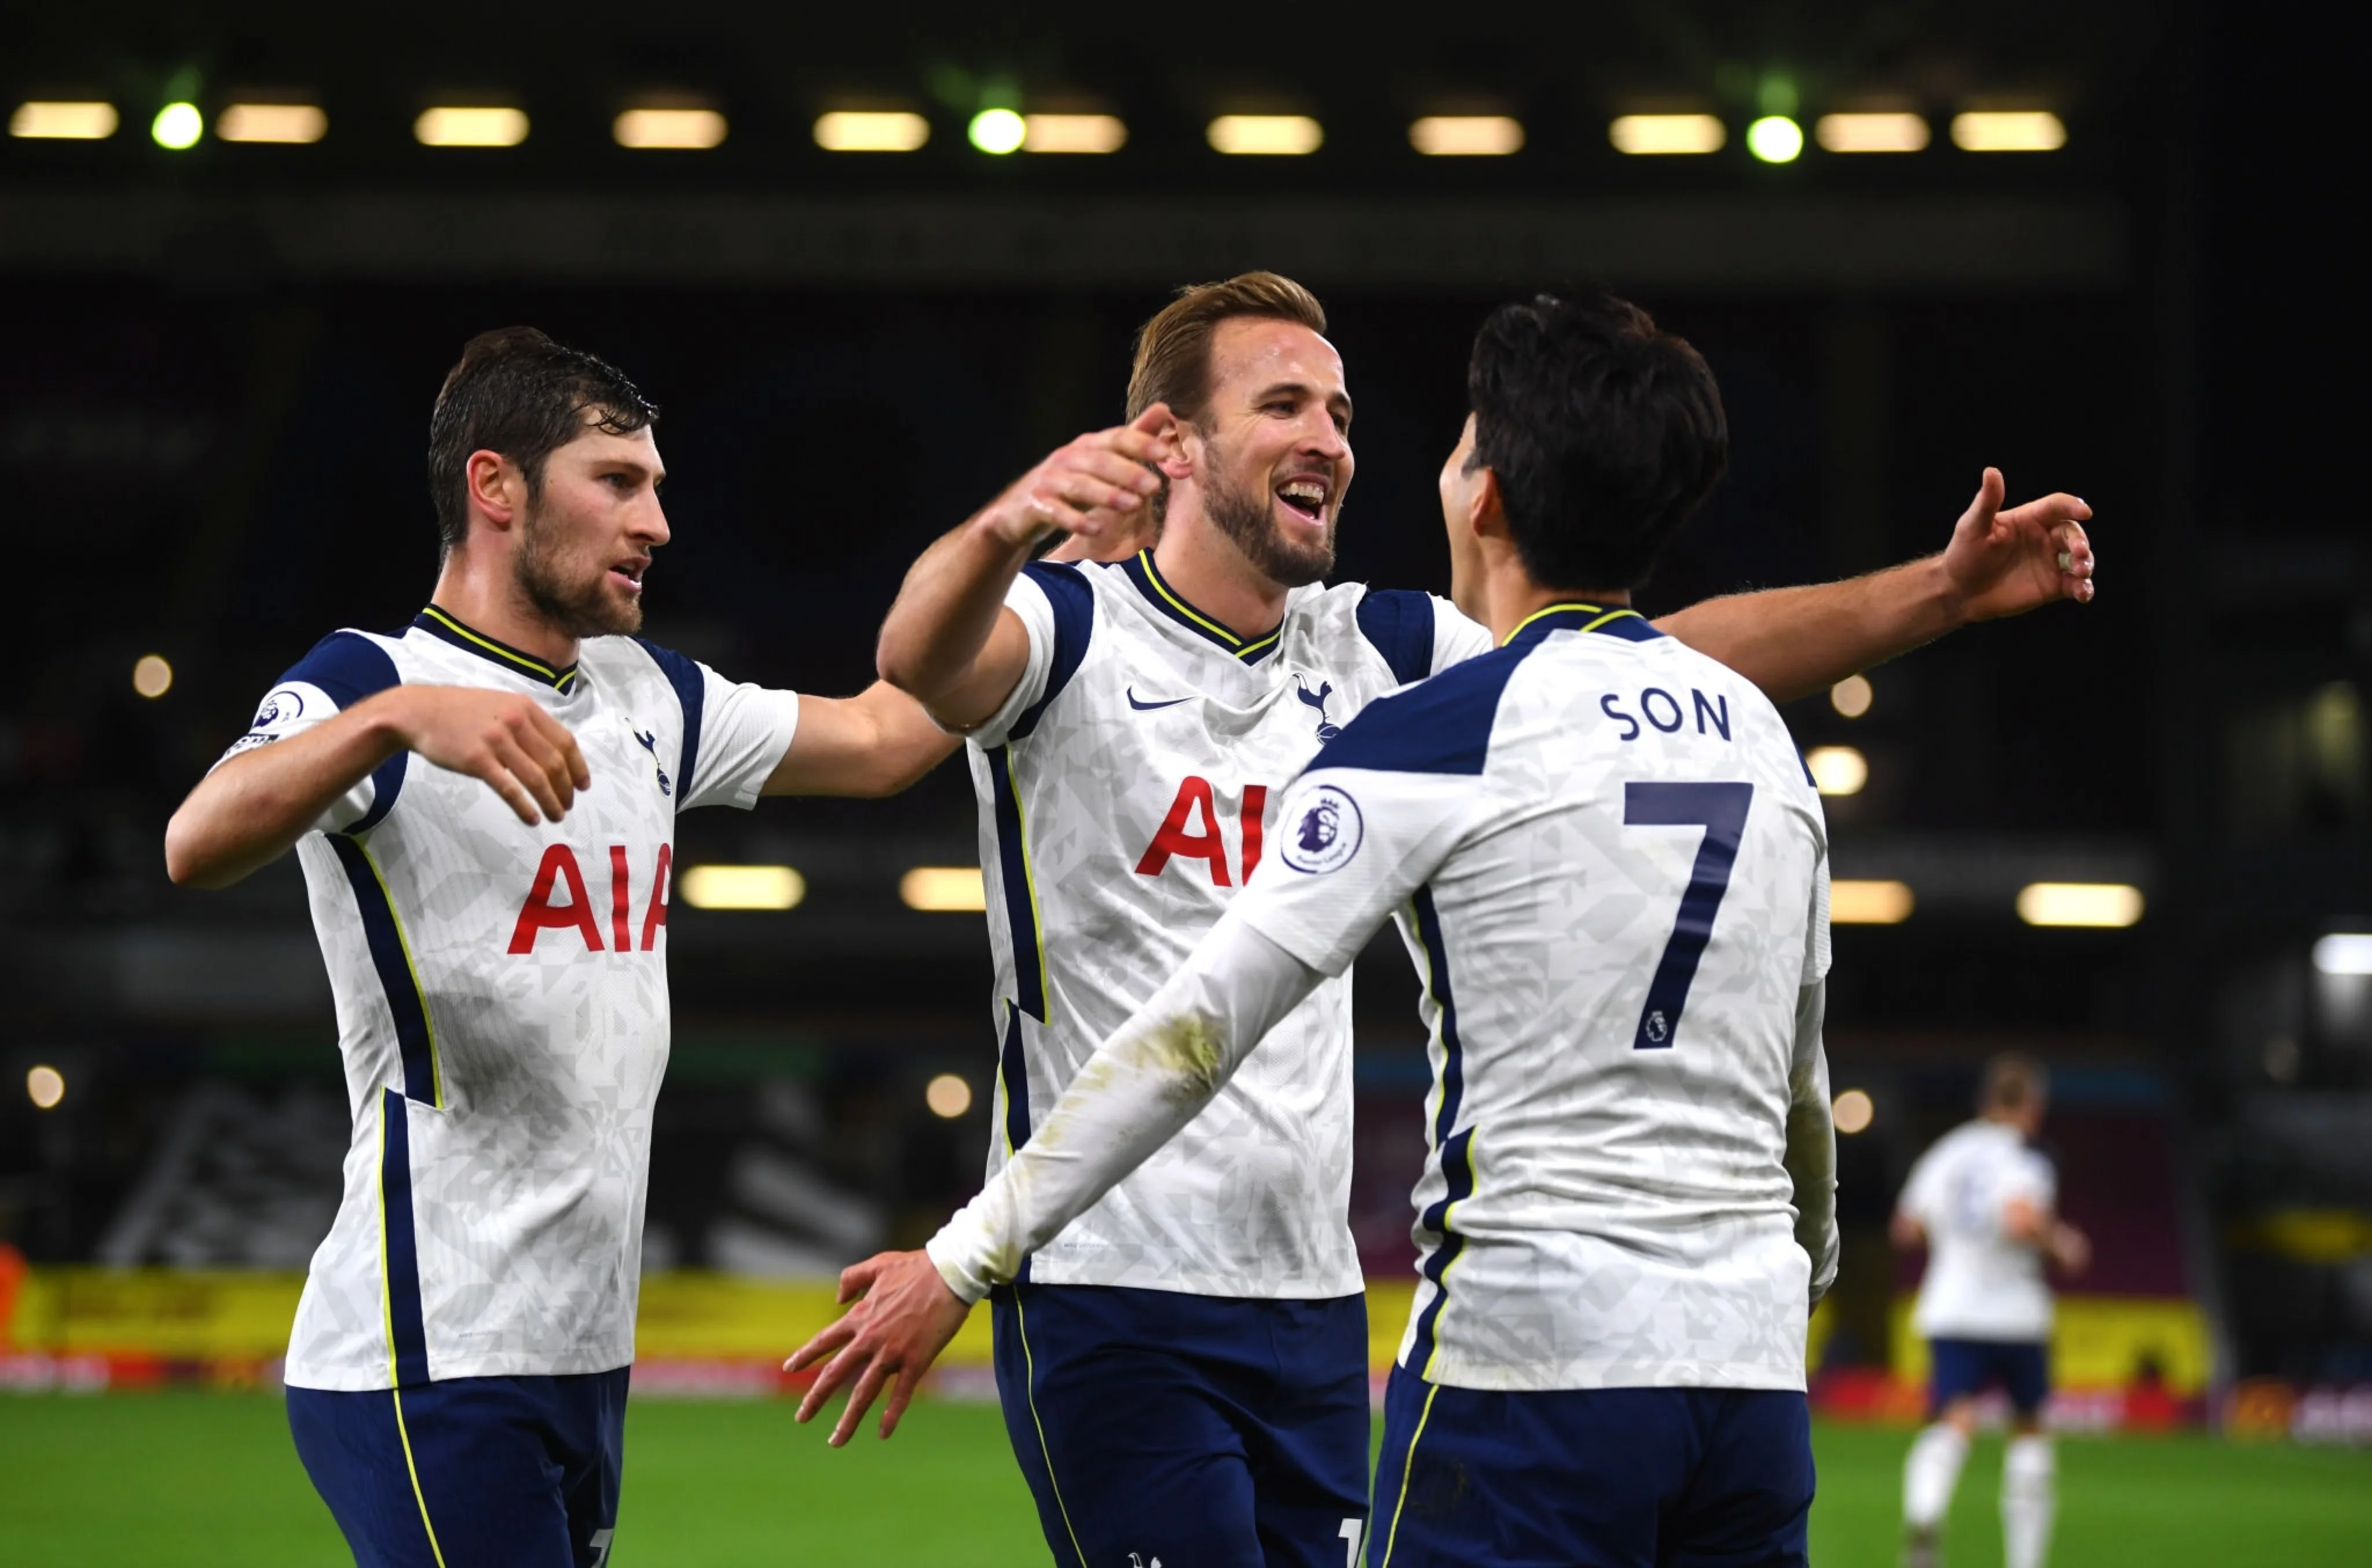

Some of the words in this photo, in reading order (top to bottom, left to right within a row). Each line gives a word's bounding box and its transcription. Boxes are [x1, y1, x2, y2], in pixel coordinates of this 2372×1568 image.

[1601, 688, 1731, 741] SON
[507, 842, 672, 955] AIA
[1623, 782, 1754, 1049] 7
[1338, 1518, 1366, 1568] 1
